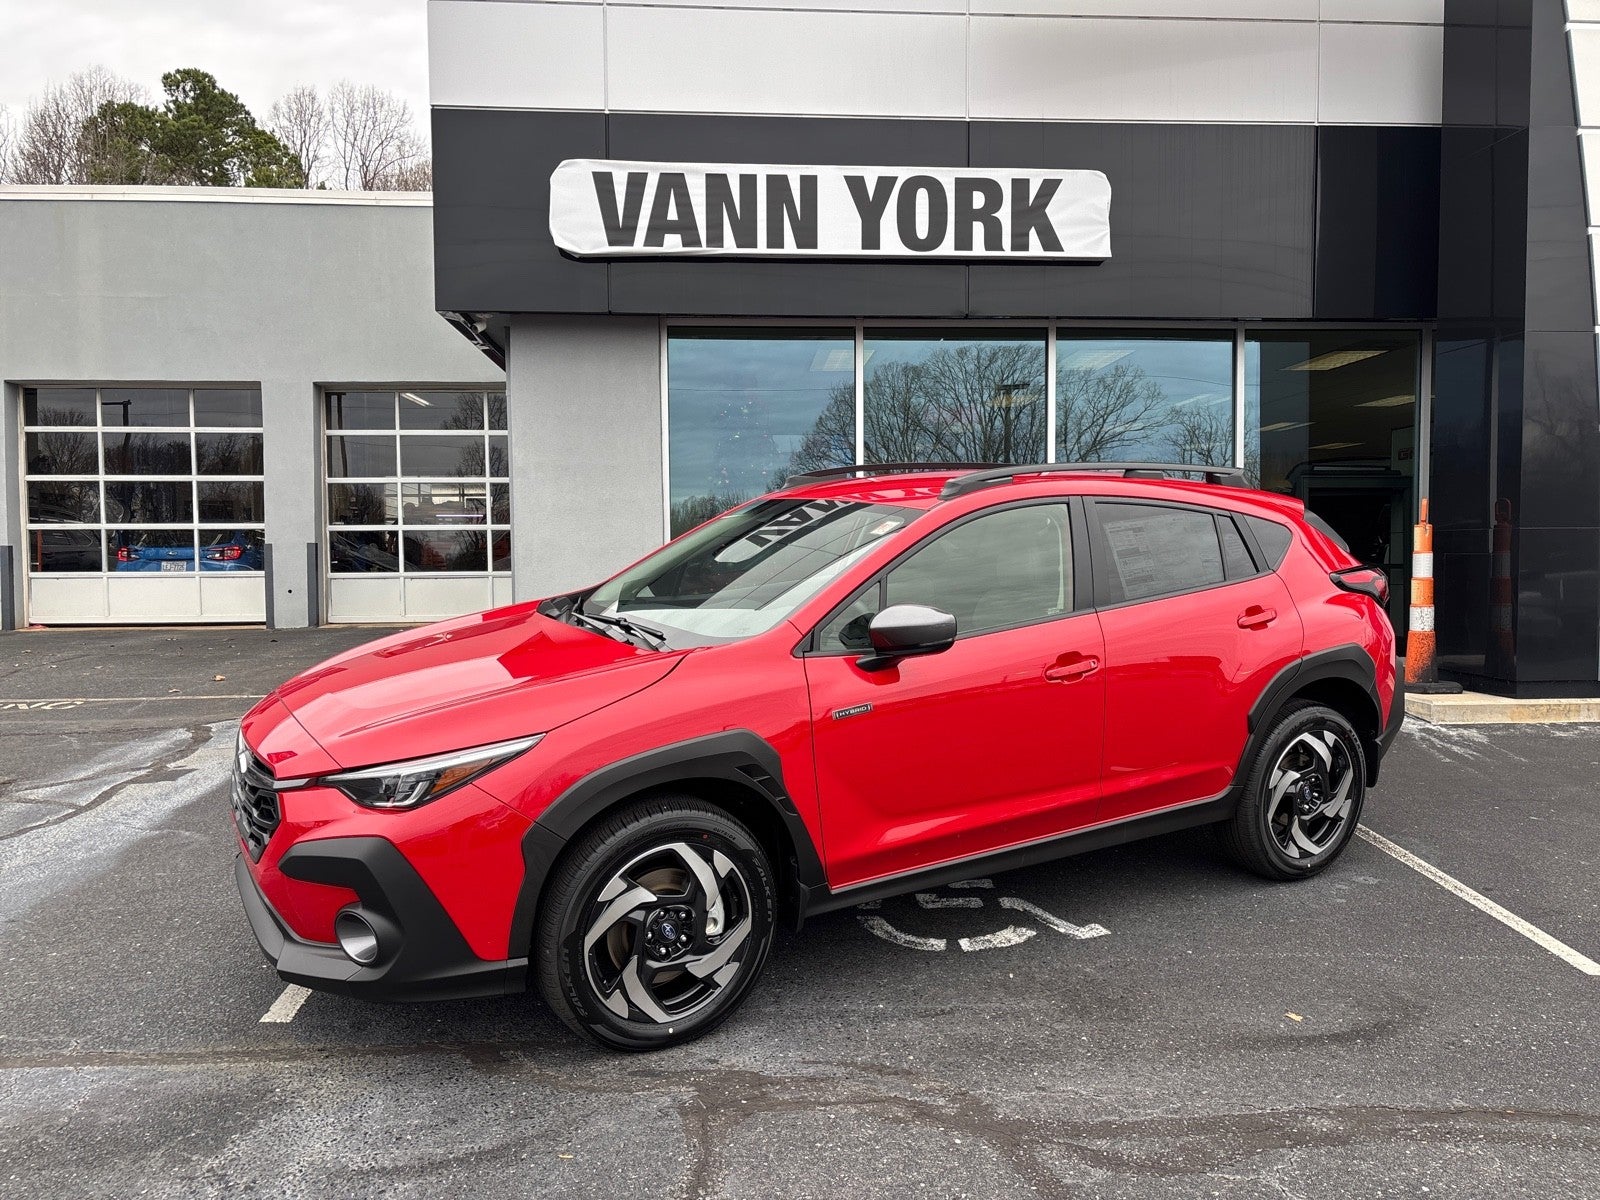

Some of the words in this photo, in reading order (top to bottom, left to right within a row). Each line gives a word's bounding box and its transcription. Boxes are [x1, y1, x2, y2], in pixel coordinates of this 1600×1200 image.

[591, 171, 818, 249] VANN
[842, 174, 1065, 253] YORK
[839, 705, 867, 717] HYBRID
[752, 857, 773, 922] FALKEN
[561, 946, 588, 1017] FALKEN
